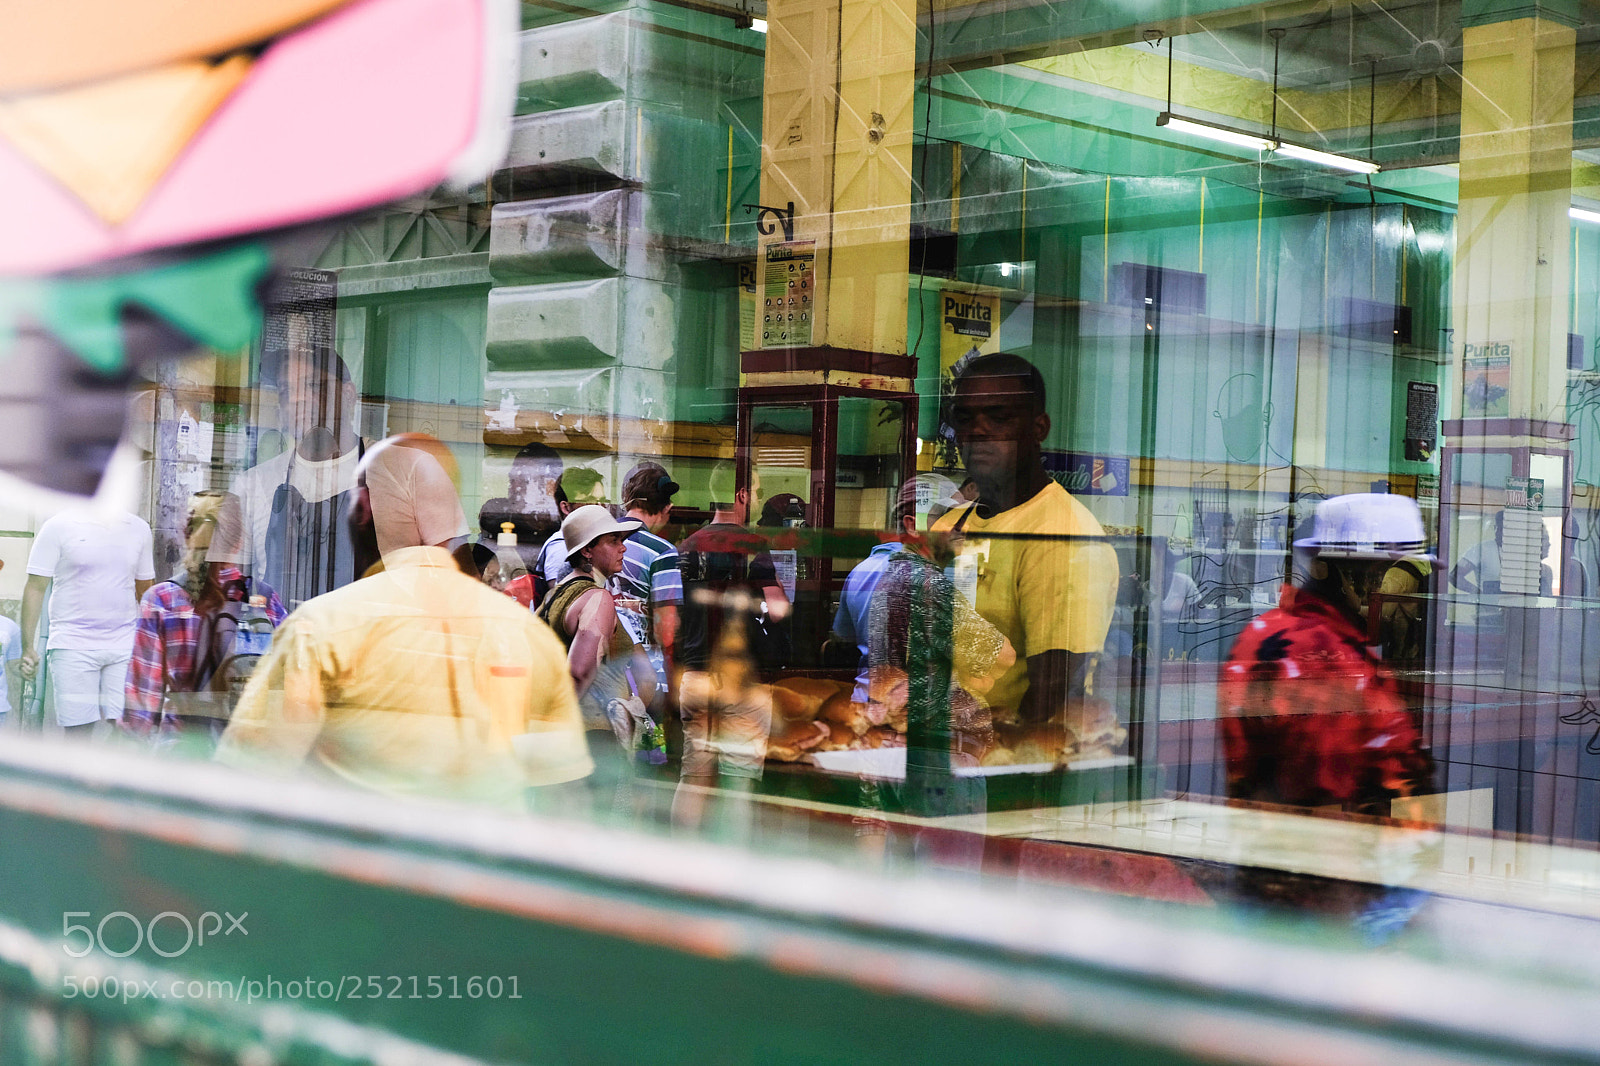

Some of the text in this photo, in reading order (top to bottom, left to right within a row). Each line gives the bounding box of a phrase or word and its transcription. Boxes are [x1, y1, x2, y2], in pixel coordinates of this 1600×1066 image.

[766, 246, 793, 259] Purita
[944, 296, 992, 321] Purita
[1464, 342, 1510, 357] Purita
